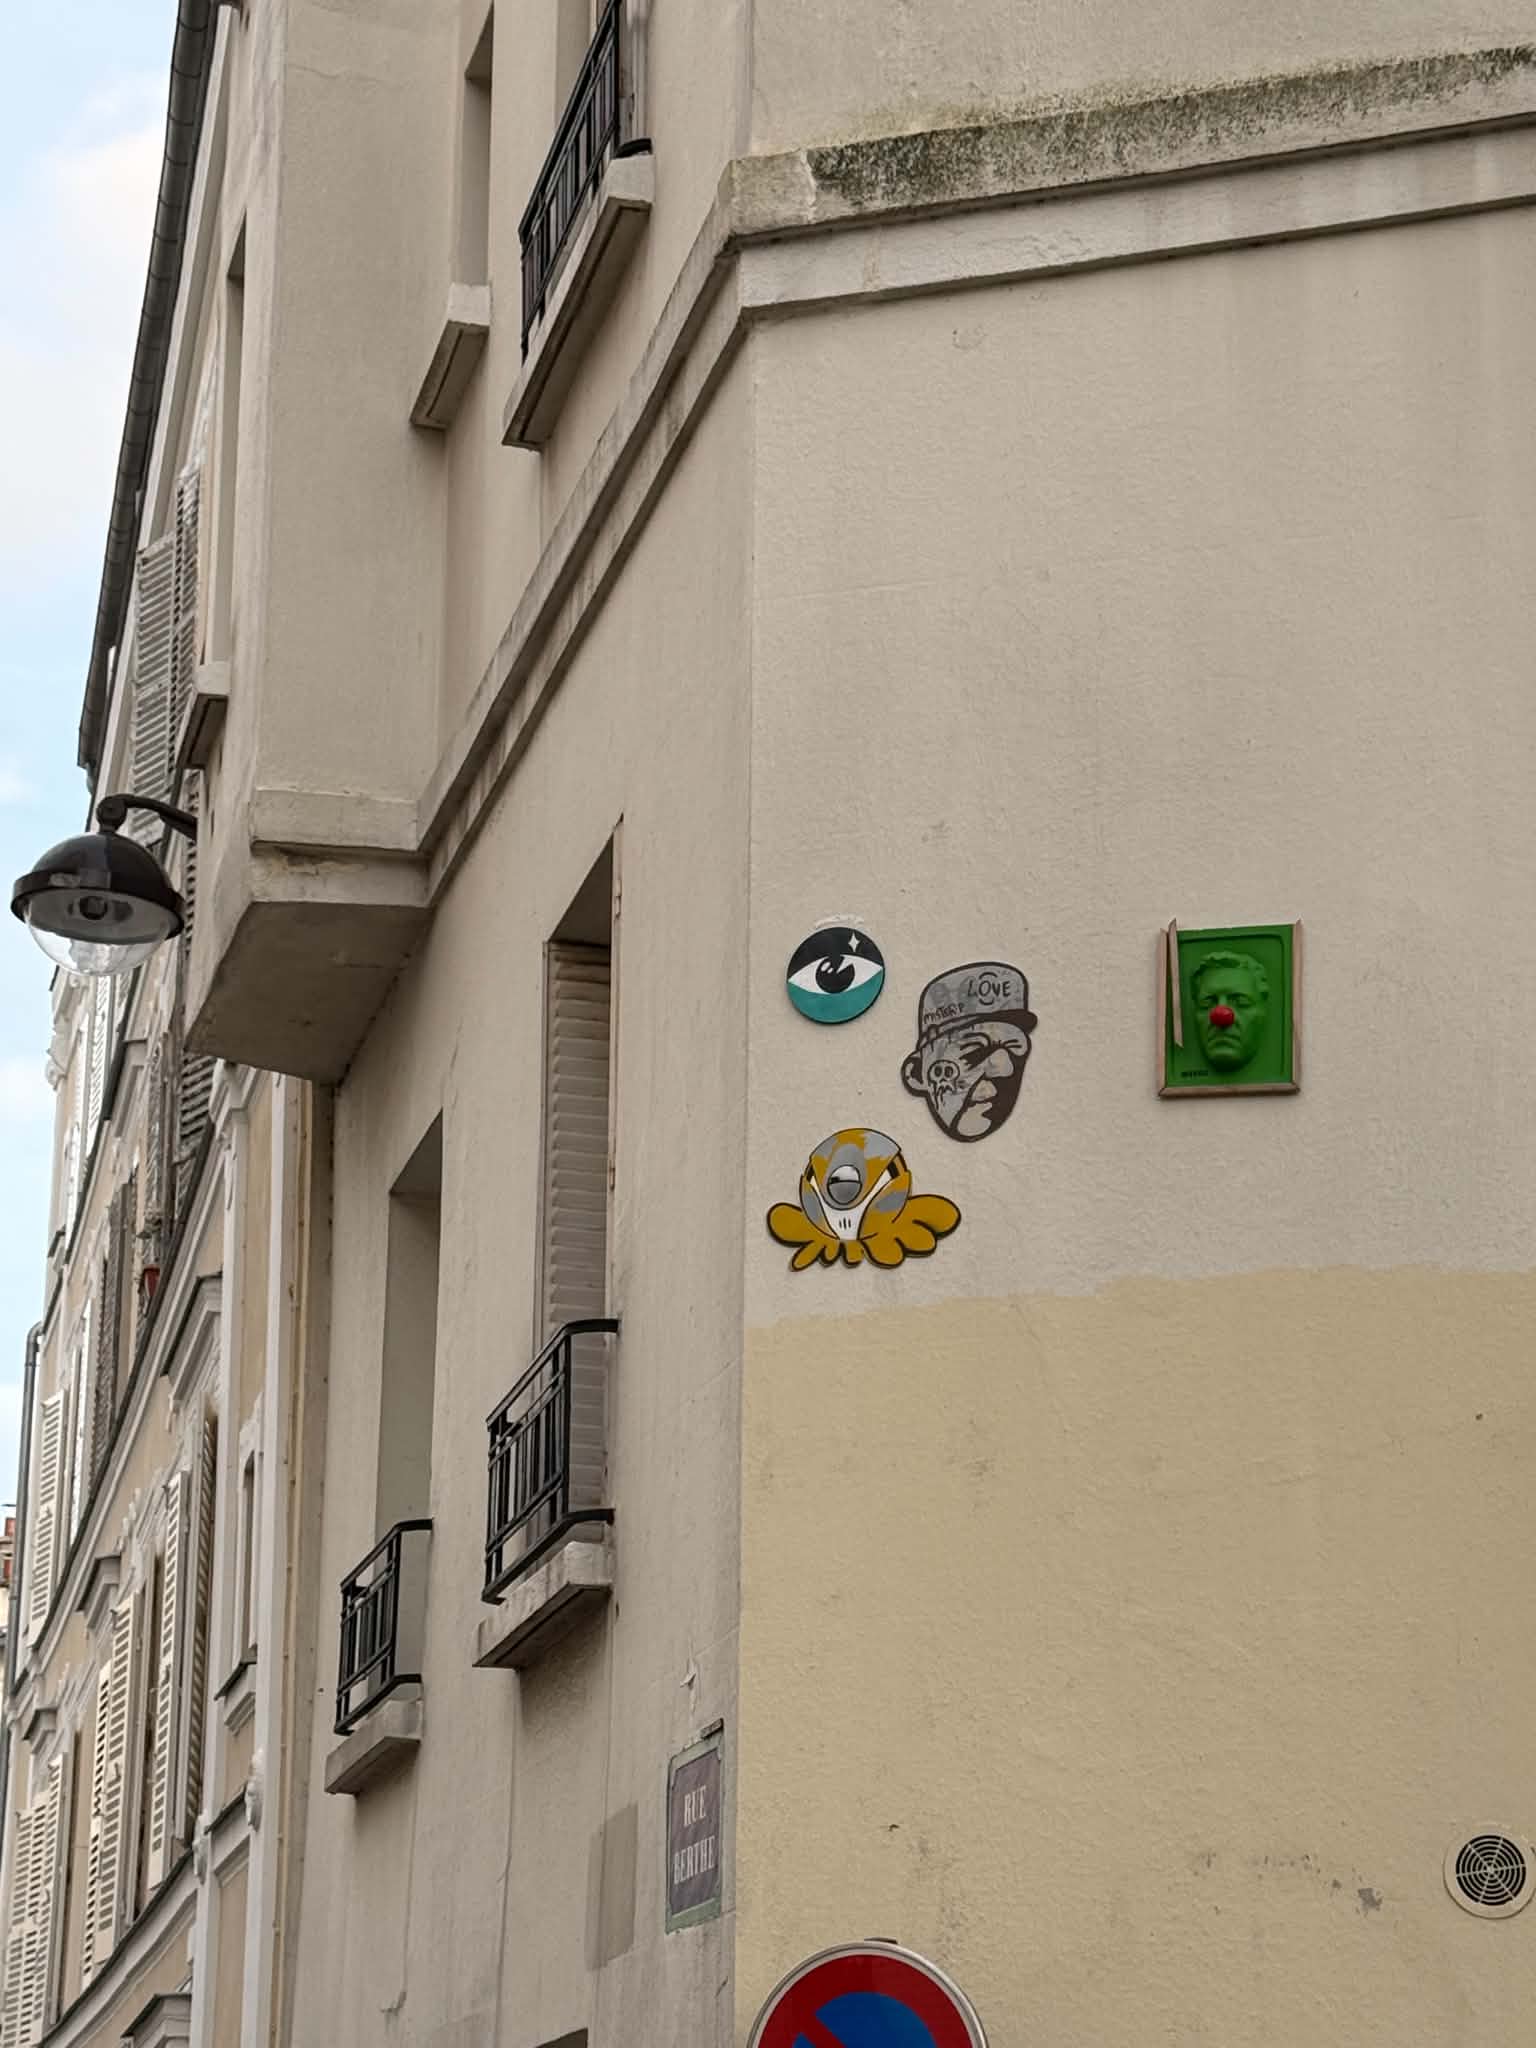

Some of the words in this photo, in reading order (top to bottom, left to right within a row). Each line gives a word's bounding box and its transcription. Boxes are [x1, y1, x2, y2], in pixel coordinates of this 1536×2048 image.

[967, 979, 1011, 998] LOVE
[683, 1785, 707, 1828] RUE
[673, 1835, 716, 1885] BERTHE
